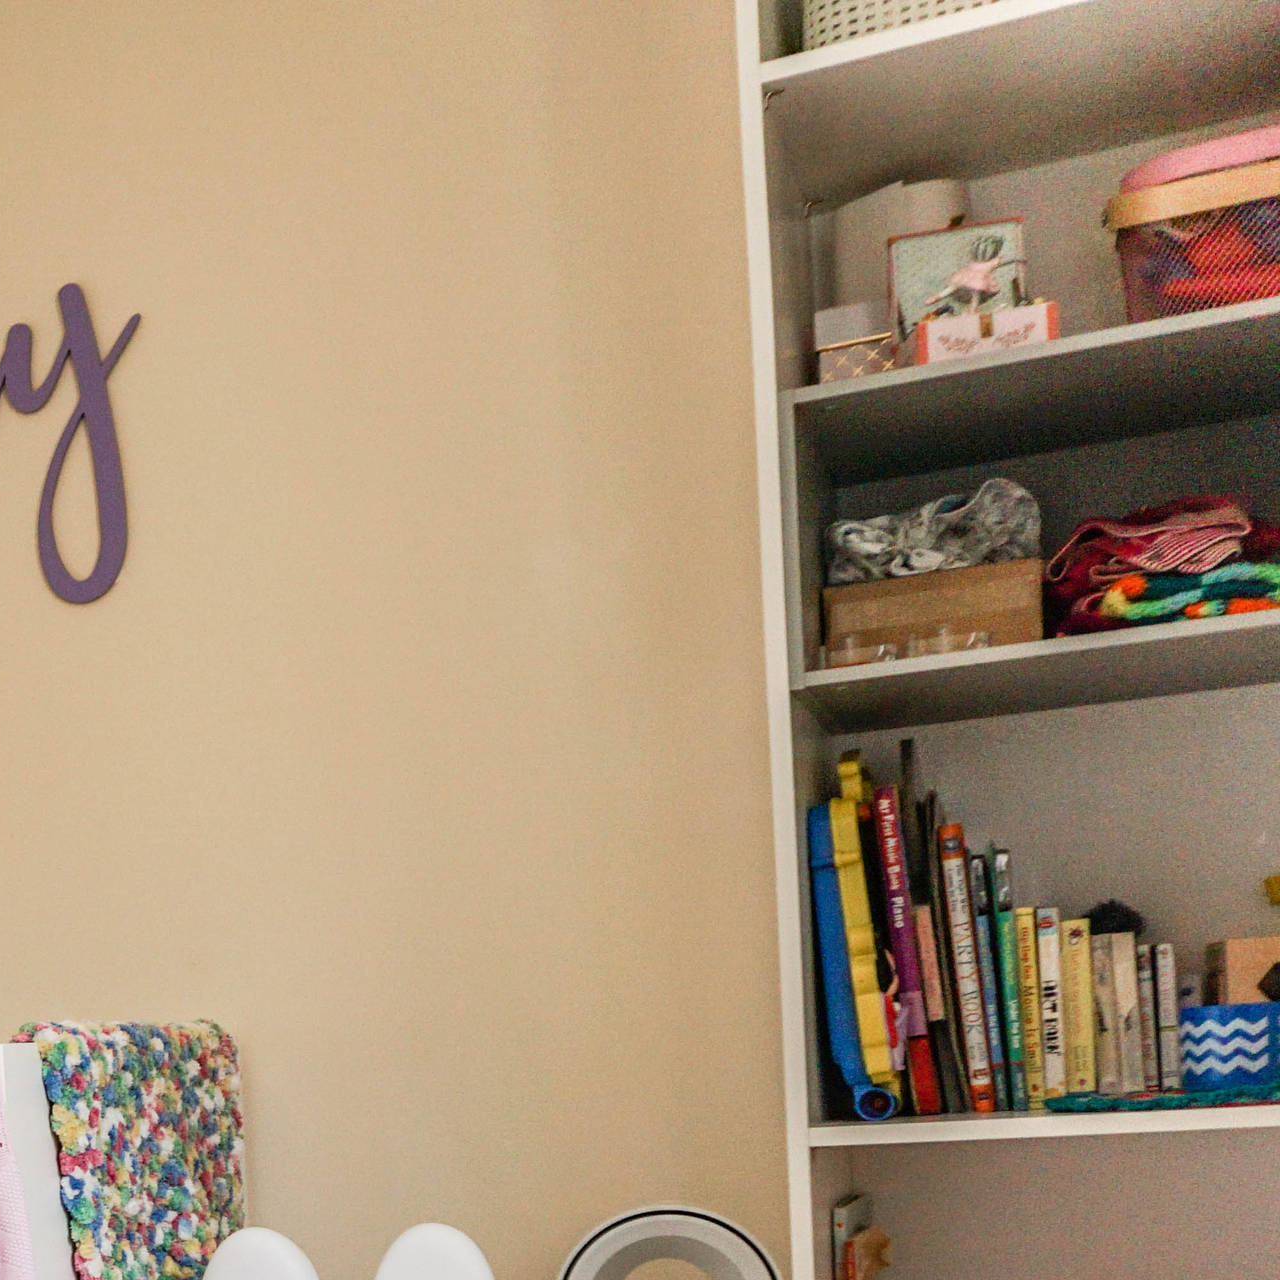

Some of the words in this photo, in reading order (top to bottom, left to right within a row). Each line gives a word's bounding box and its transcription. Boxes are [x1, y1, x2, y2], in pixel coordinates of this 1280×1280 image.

[892, 896, 906, 928] Piano
[952, 921, 979, 983] PARTY
[960, 991, 983, 1034] BOOK
